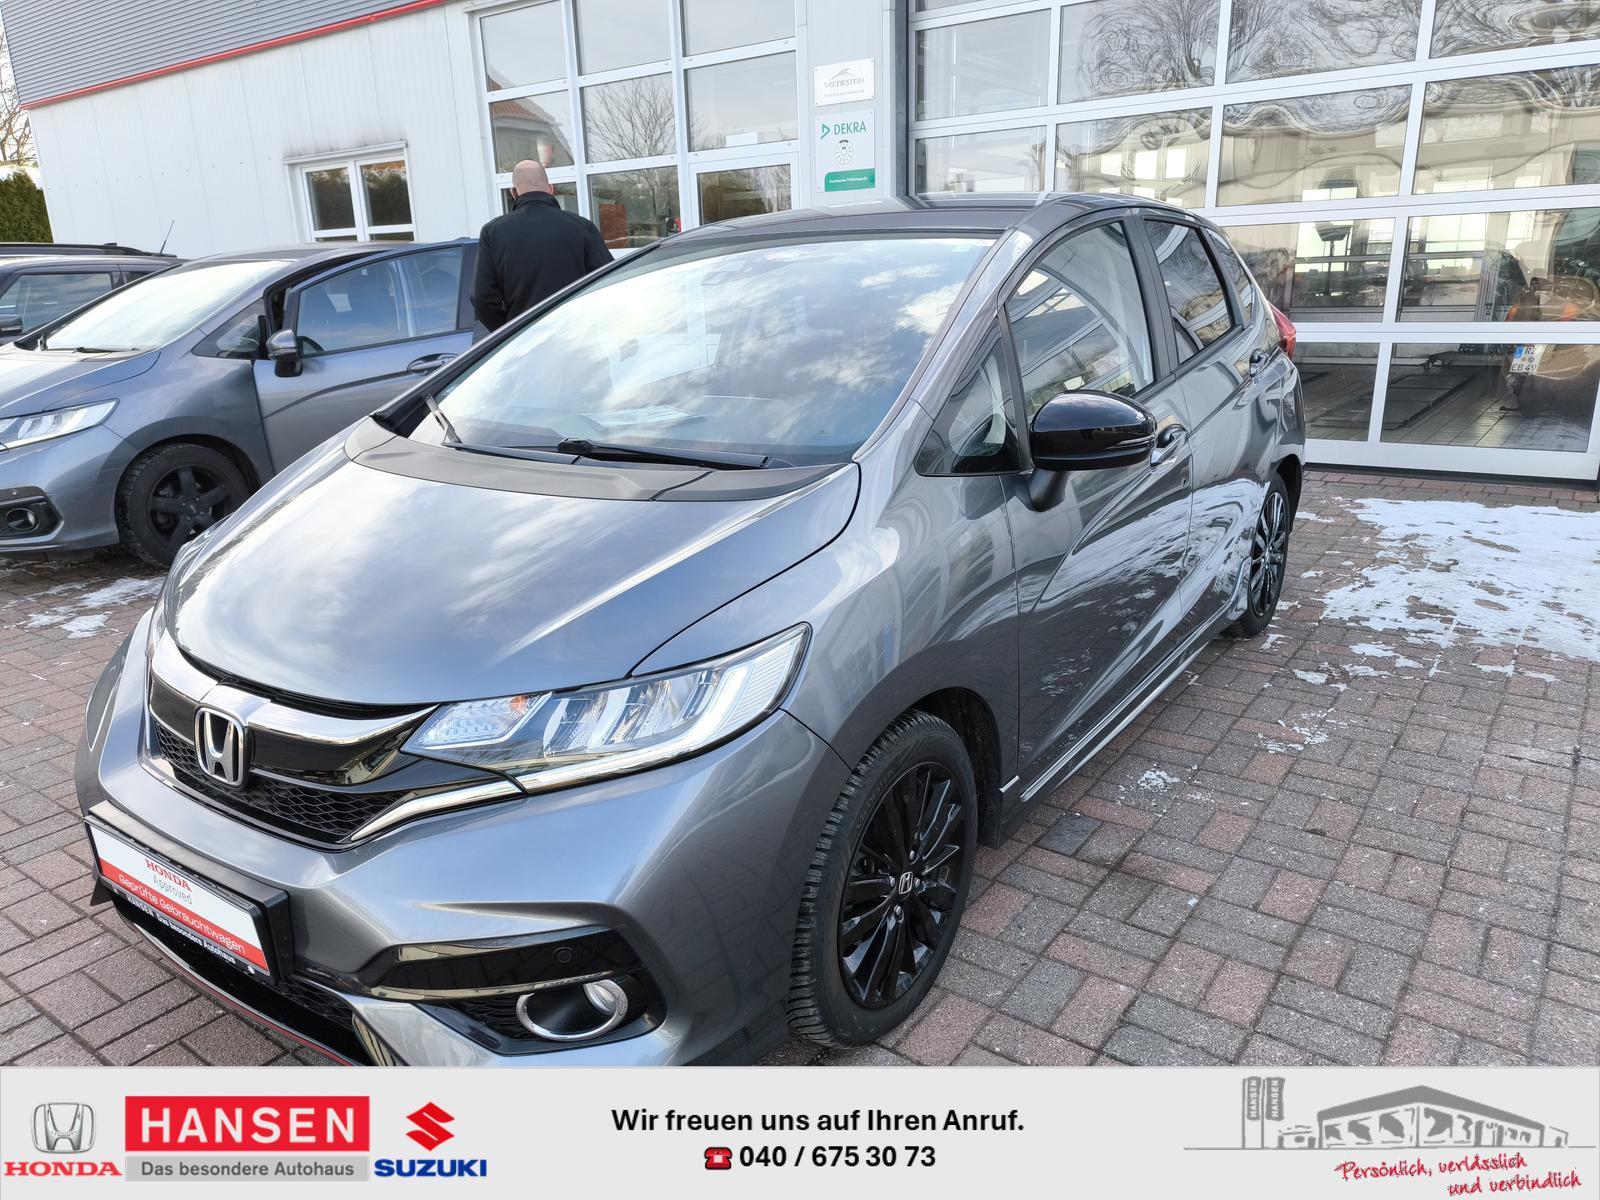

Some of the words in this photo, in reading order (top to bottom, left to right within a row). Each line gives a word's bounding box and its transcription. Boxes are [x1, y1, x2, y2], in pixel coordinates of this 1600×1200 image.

[833, 121, 867, 136] DEKRA
[144, 858, 193, 892] HONDA
[152, 874, 193, 904] Approved
[118, 873, 158, 905] Geprüfte
[159, 893, 246, 954] Gebrauchtwagen
